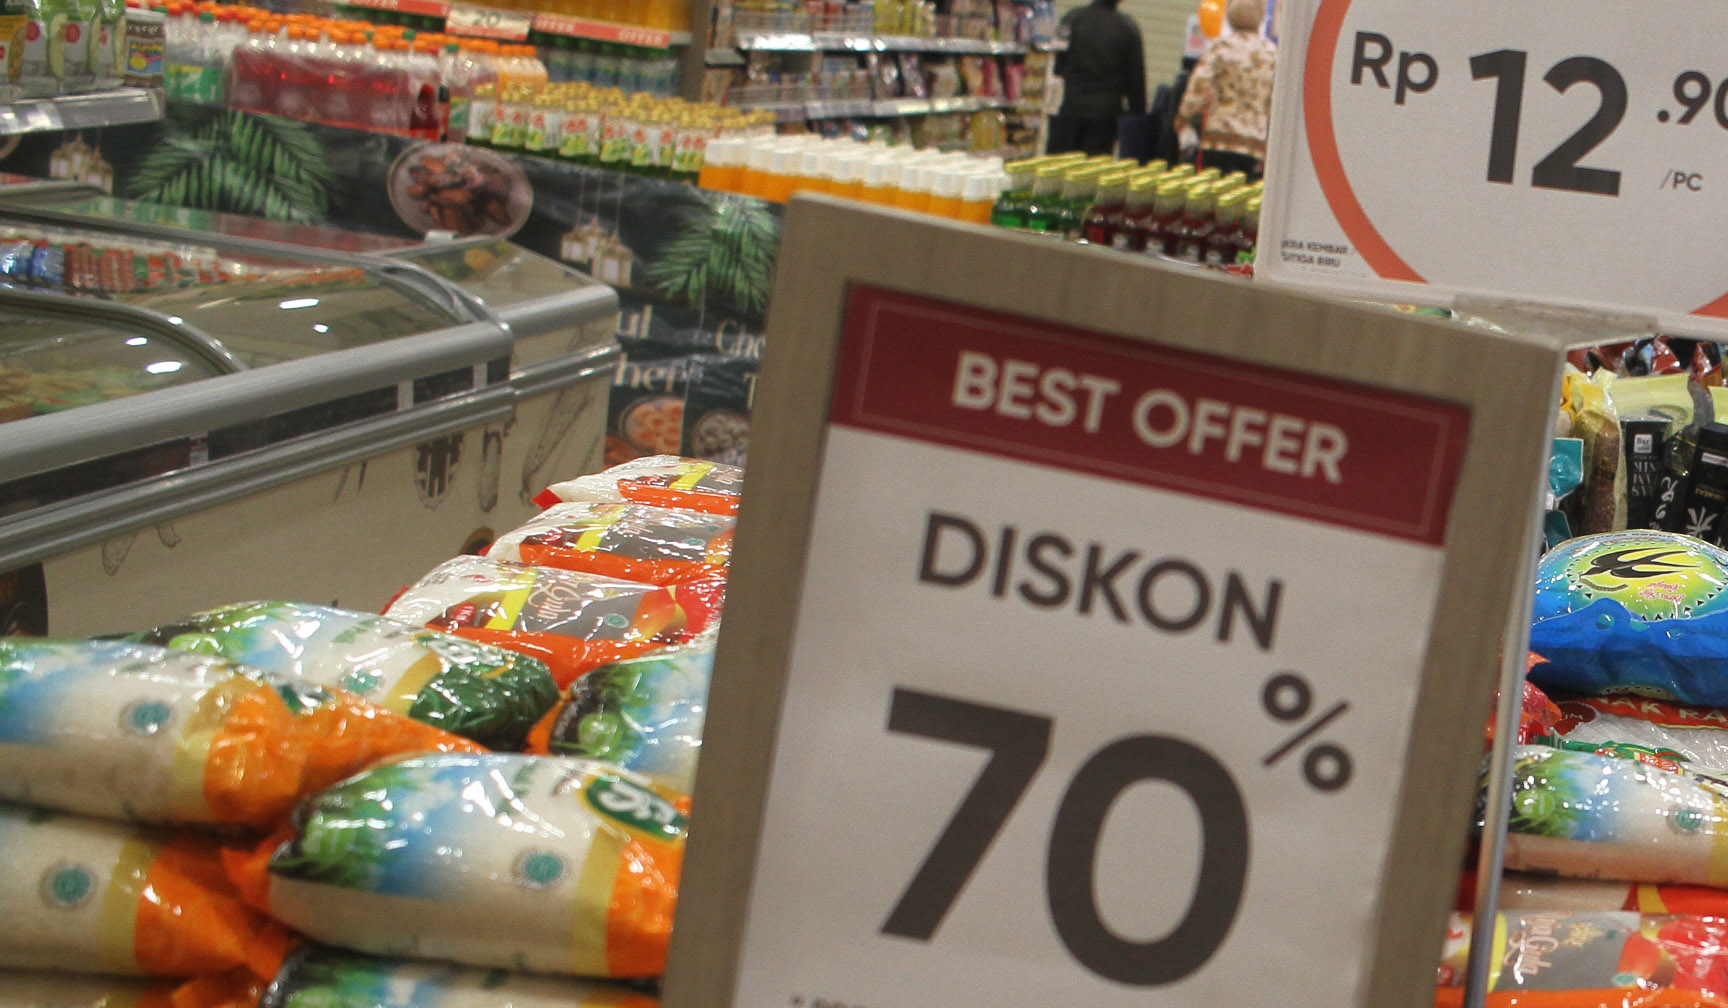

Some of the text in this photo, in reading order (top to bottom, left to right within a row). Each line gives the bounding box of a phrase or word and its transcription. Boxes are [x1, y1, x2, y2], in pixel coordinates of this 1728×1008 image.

[1350, 31, 1439, 105] Rp
[1469, 48, 1630, 197] 12
[1659, 169, 1704, 192] /PC
[952, 351, 1348, 486] BEST OFFER
[917, 510, 1285, 653] DISKON
